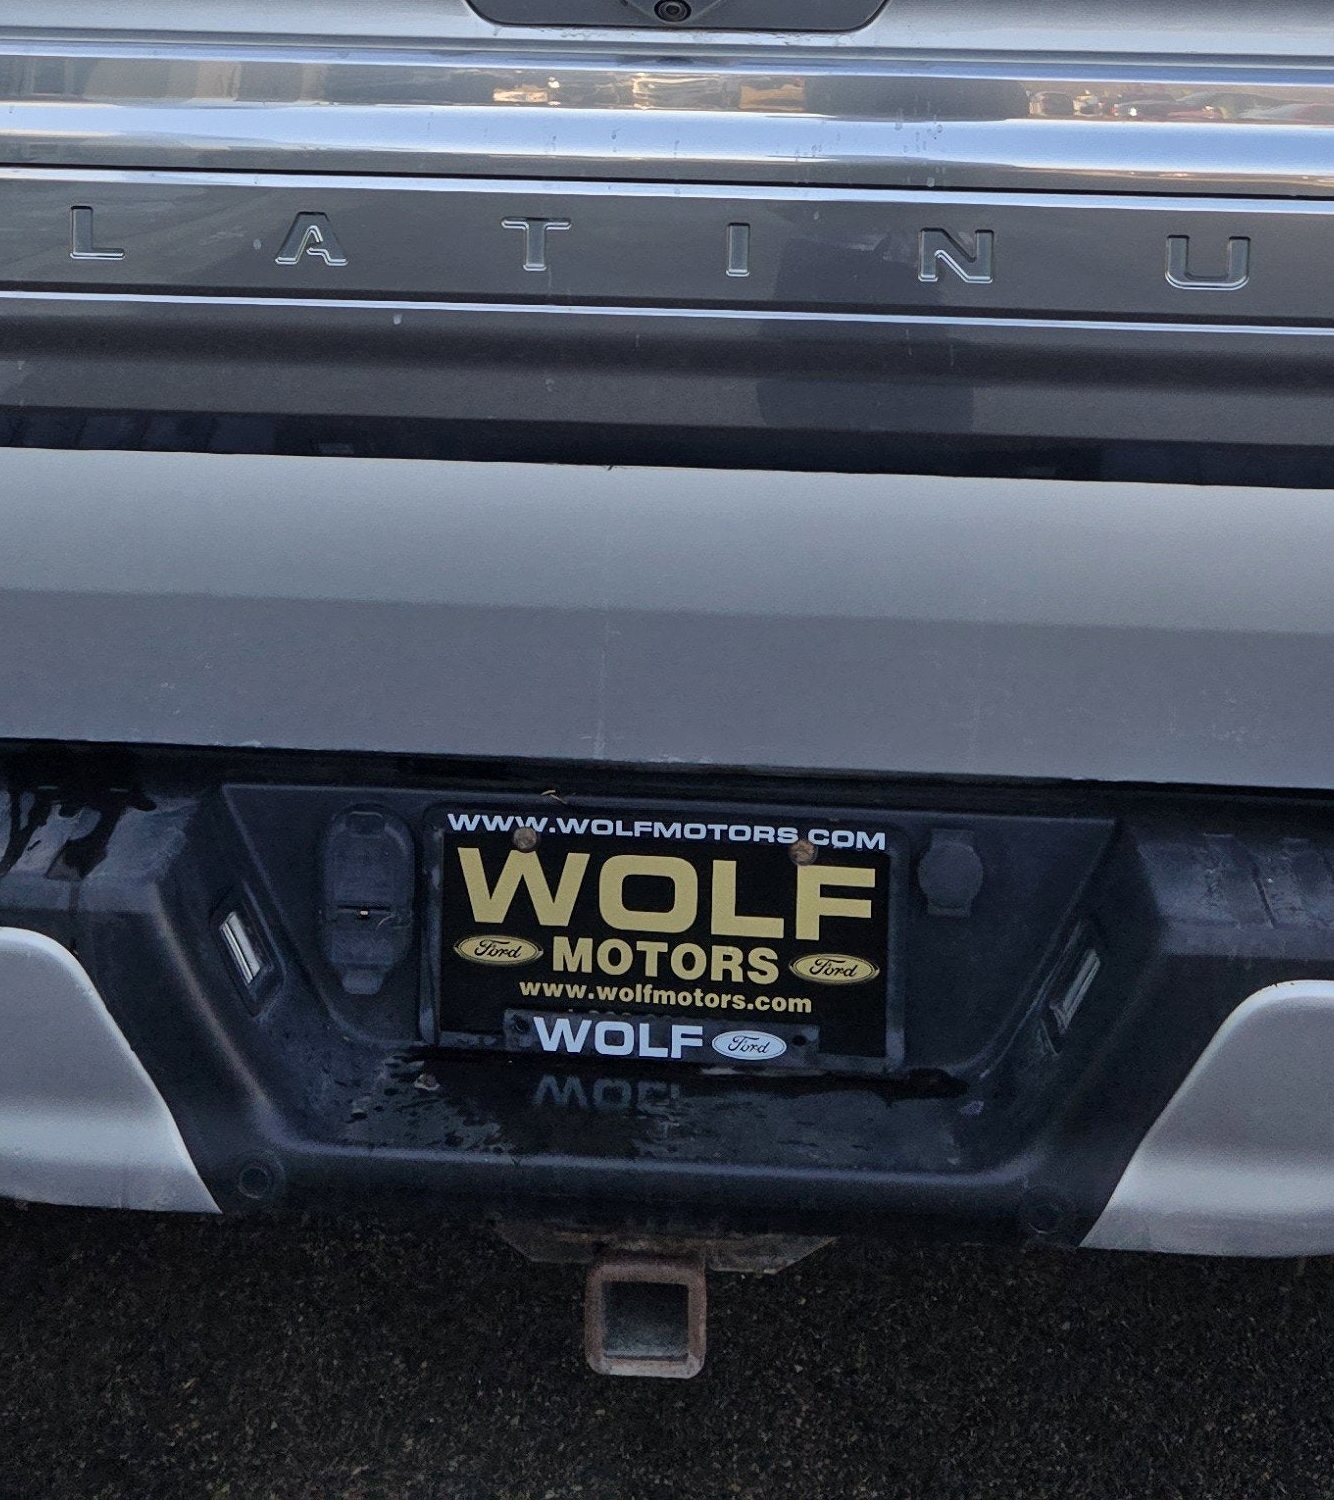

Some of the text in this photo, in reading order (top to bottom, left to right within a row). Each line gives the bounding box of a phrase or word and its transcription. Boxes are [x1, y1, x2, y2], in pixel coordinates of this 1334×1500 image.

[447, 813, 886, 851] WWW.WOLFMOTORSCOM
[457, 847, 876, 941] WOLF
[474, 939, 522, 959] Ford
[552, 935, 780, 985] MOTORS
[809, 958, 858, 977] Ford
[520, 980, 812, 1013] www.wolfmotors.com
[533, 1016, 704, 1060] WOLF
[728, 1035, 770, 1053] Ford
